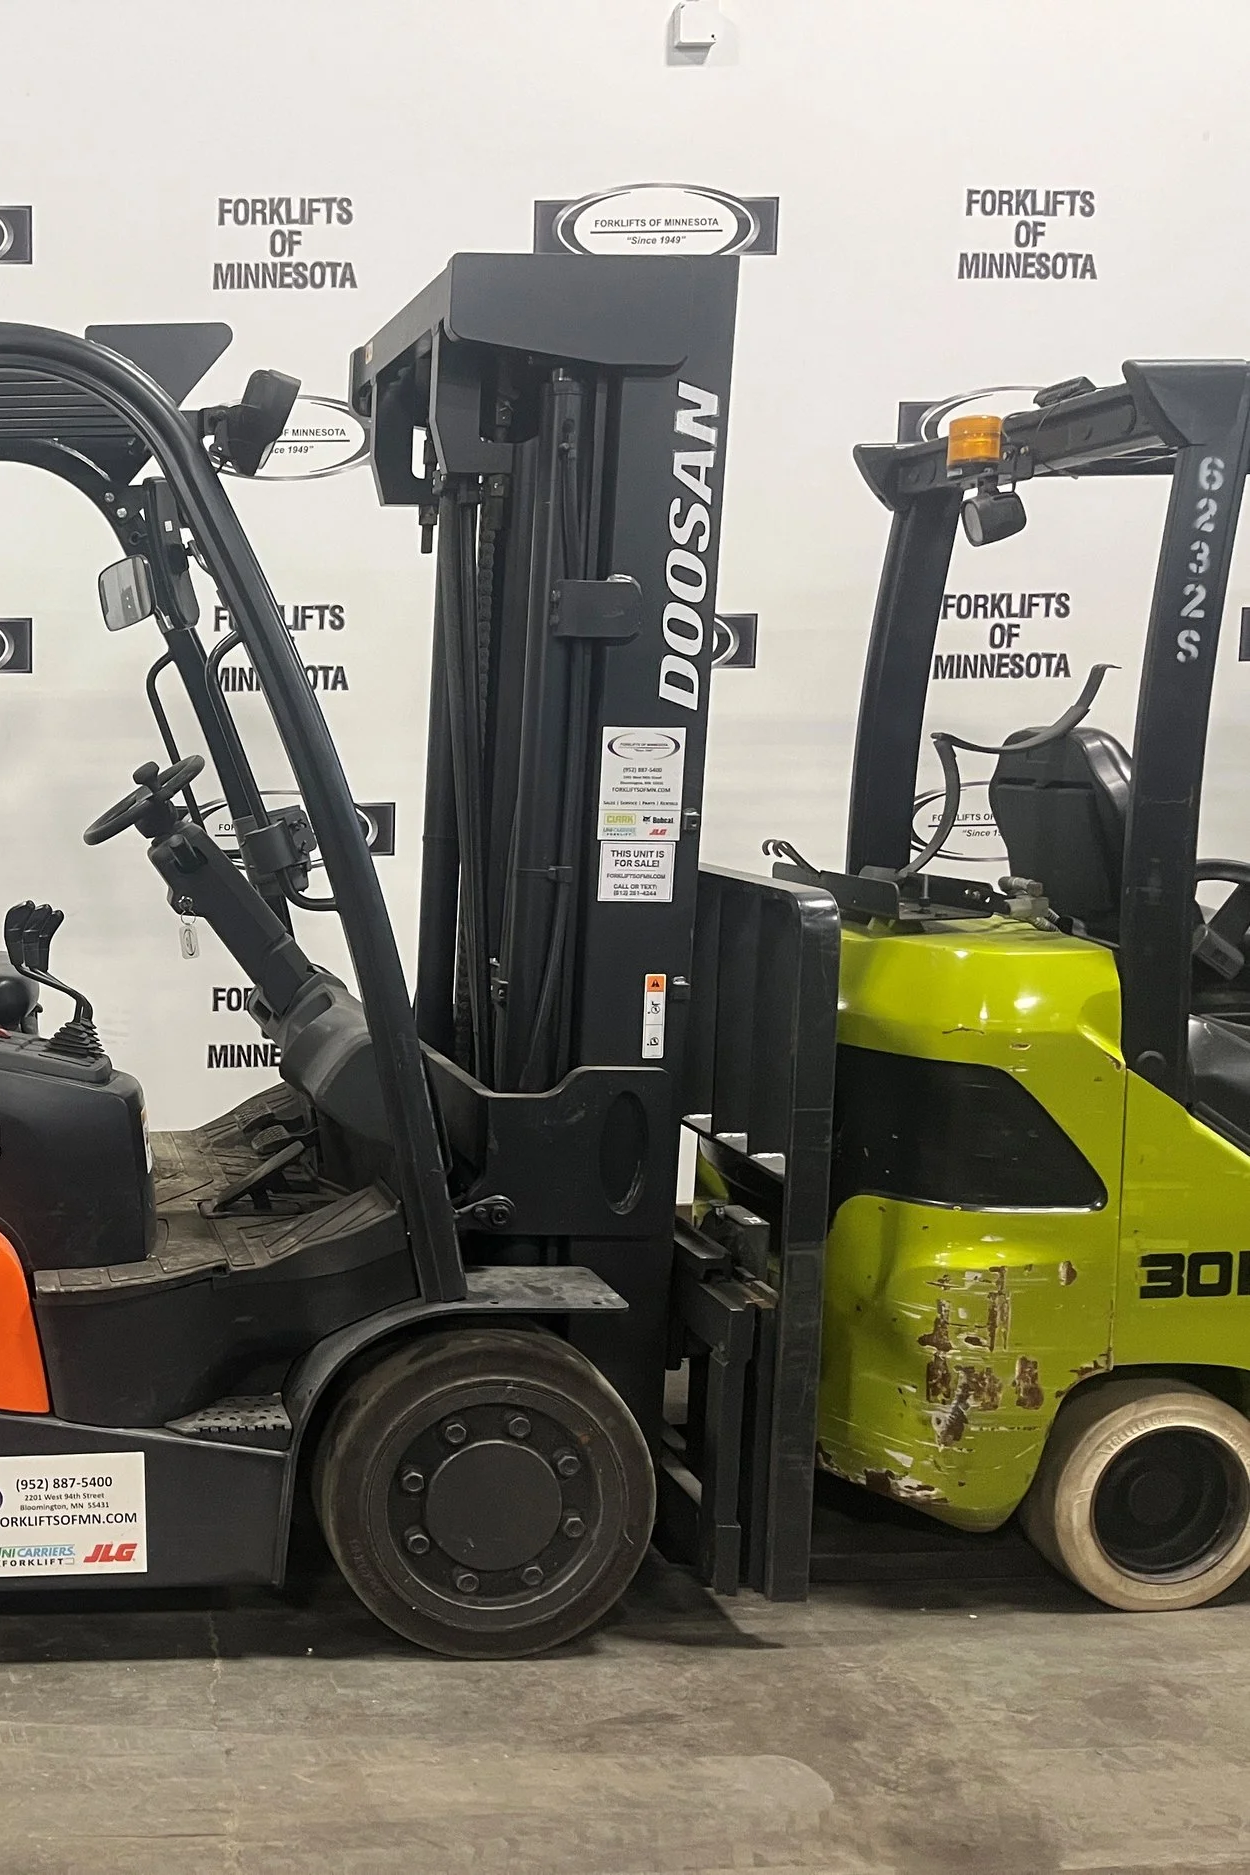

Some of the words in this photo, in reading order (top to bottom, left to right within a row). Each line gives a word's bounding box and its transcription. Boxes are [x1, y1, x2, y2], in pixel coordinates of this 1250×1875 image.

[218, 196, 353, 226] FORKLIFTS
[965, 188, 1095, 217] FORKLIFTS
[594, 218, 646, 228] FORKLIFTS
[649, 218, 663, 227] OF
[664, 217, 719, 226] MINNESOTA
[1014, 220, 1046, 248] OF
[270, 229, 302, 257] OF
[213, 261, 358, 290] MINNESOTA
[958, 252, 1097, 280] MINNESOTA
[292, 428, 346, 437] MINNESOTA
[659, 381, 719, 711] DOOSAN
[1176, 456, 1225, 663] 6232S
[941, 593, 1070, 620] FORKLIFTS
[989, 622, 1020, 649] OF
[932, 652, 1071, 680] MINNESOTA
[653, 816, 674, 824] Bobcat
[610, 850, 632, 858] THIS
[633, 850, 654, 858] UNIT
[656, 850, 665, 858] IS
[634, 860, 660, 868] SALE!
[16, 1478, 49, 1492] (952)
[52, 1476, 113, 1489] 887-5400
[64, 1492, 81, 1500] 94th
[20, 1503, 69, 1512] Bloomington,
[2, 1558, 64, 1567] FORKLIFT
[83, 1543, 138, 1563] JLG
